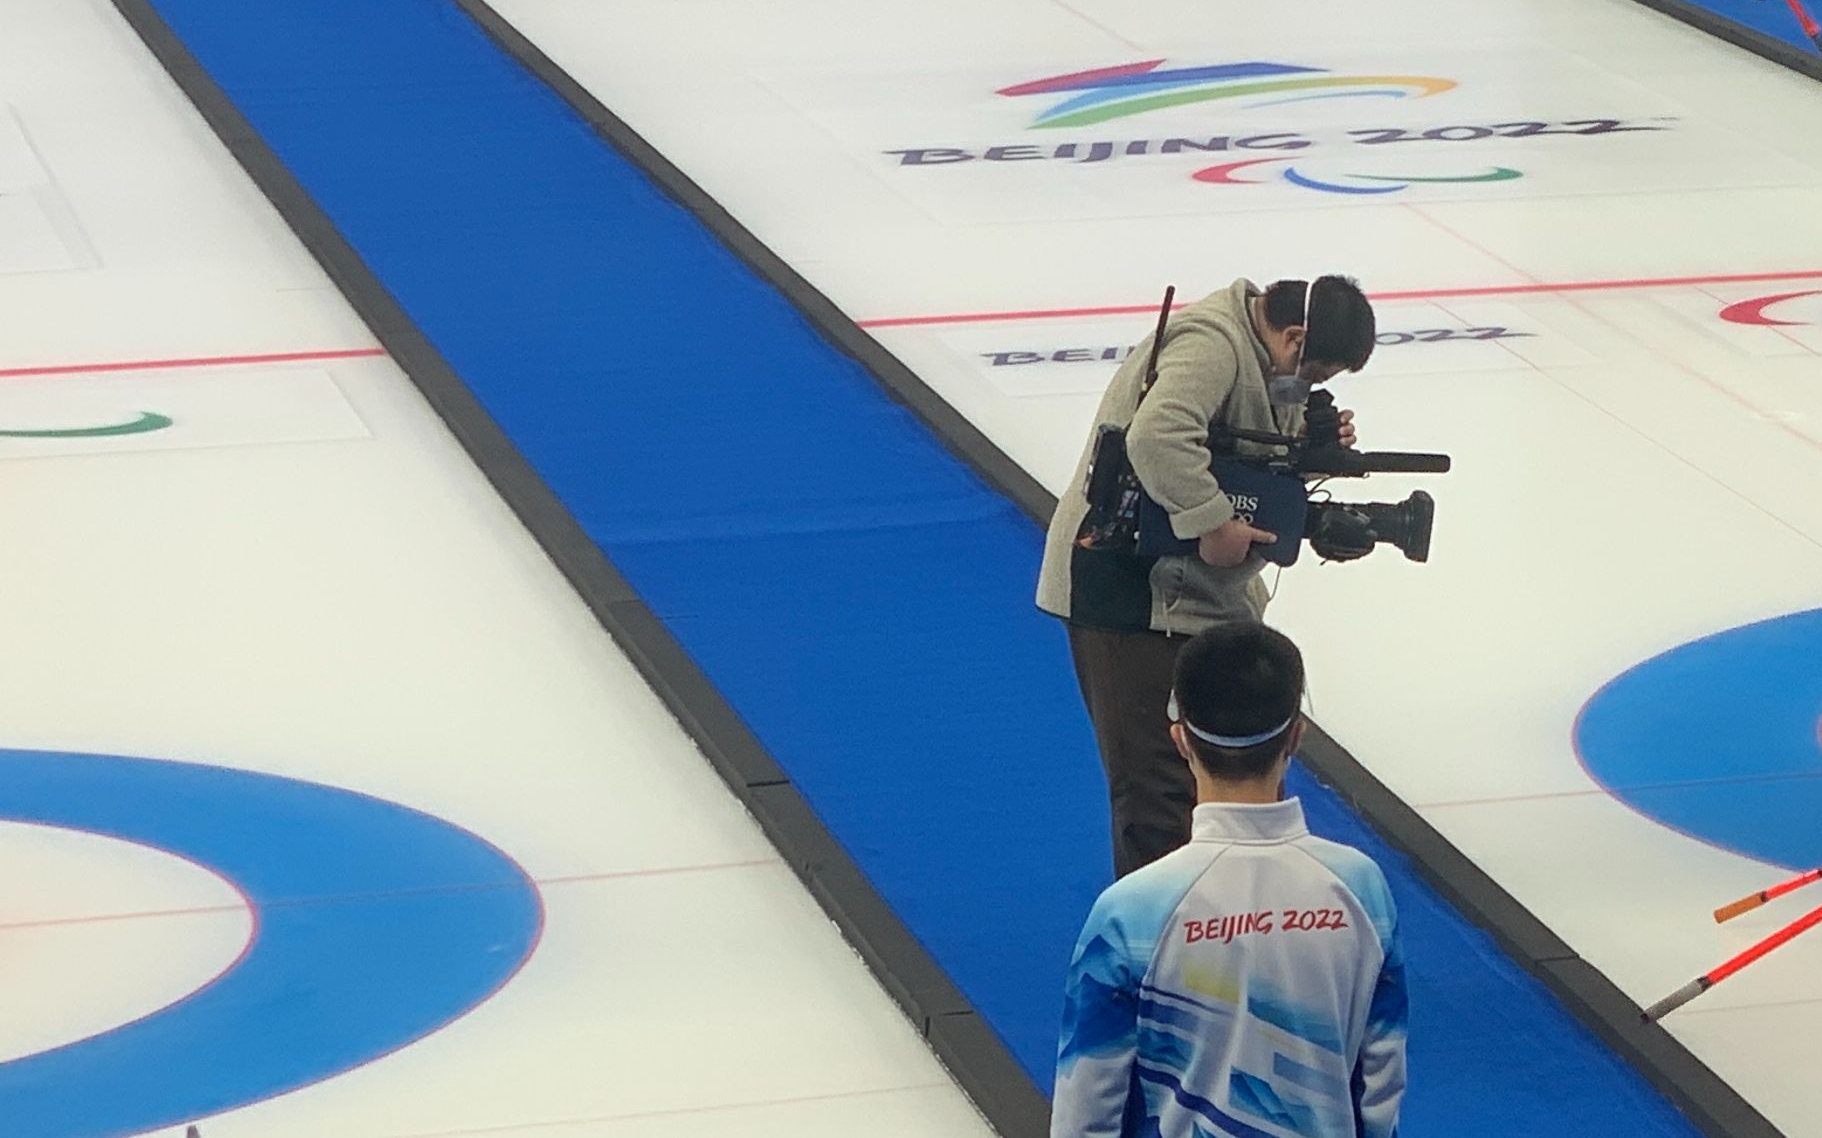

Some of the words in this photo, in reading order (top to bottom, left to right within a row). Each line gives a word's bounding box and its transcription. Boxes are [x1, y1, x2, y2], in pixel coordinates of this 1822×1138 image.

[882, 132, 1314, 166] BEIJING
[1344, 117, 1670, 147] 2022
[1374, 325, 1540, 346] 022
[1184, 911, 1274, 945] BEIJING
[1281, 909, 1350, 932] 2022
